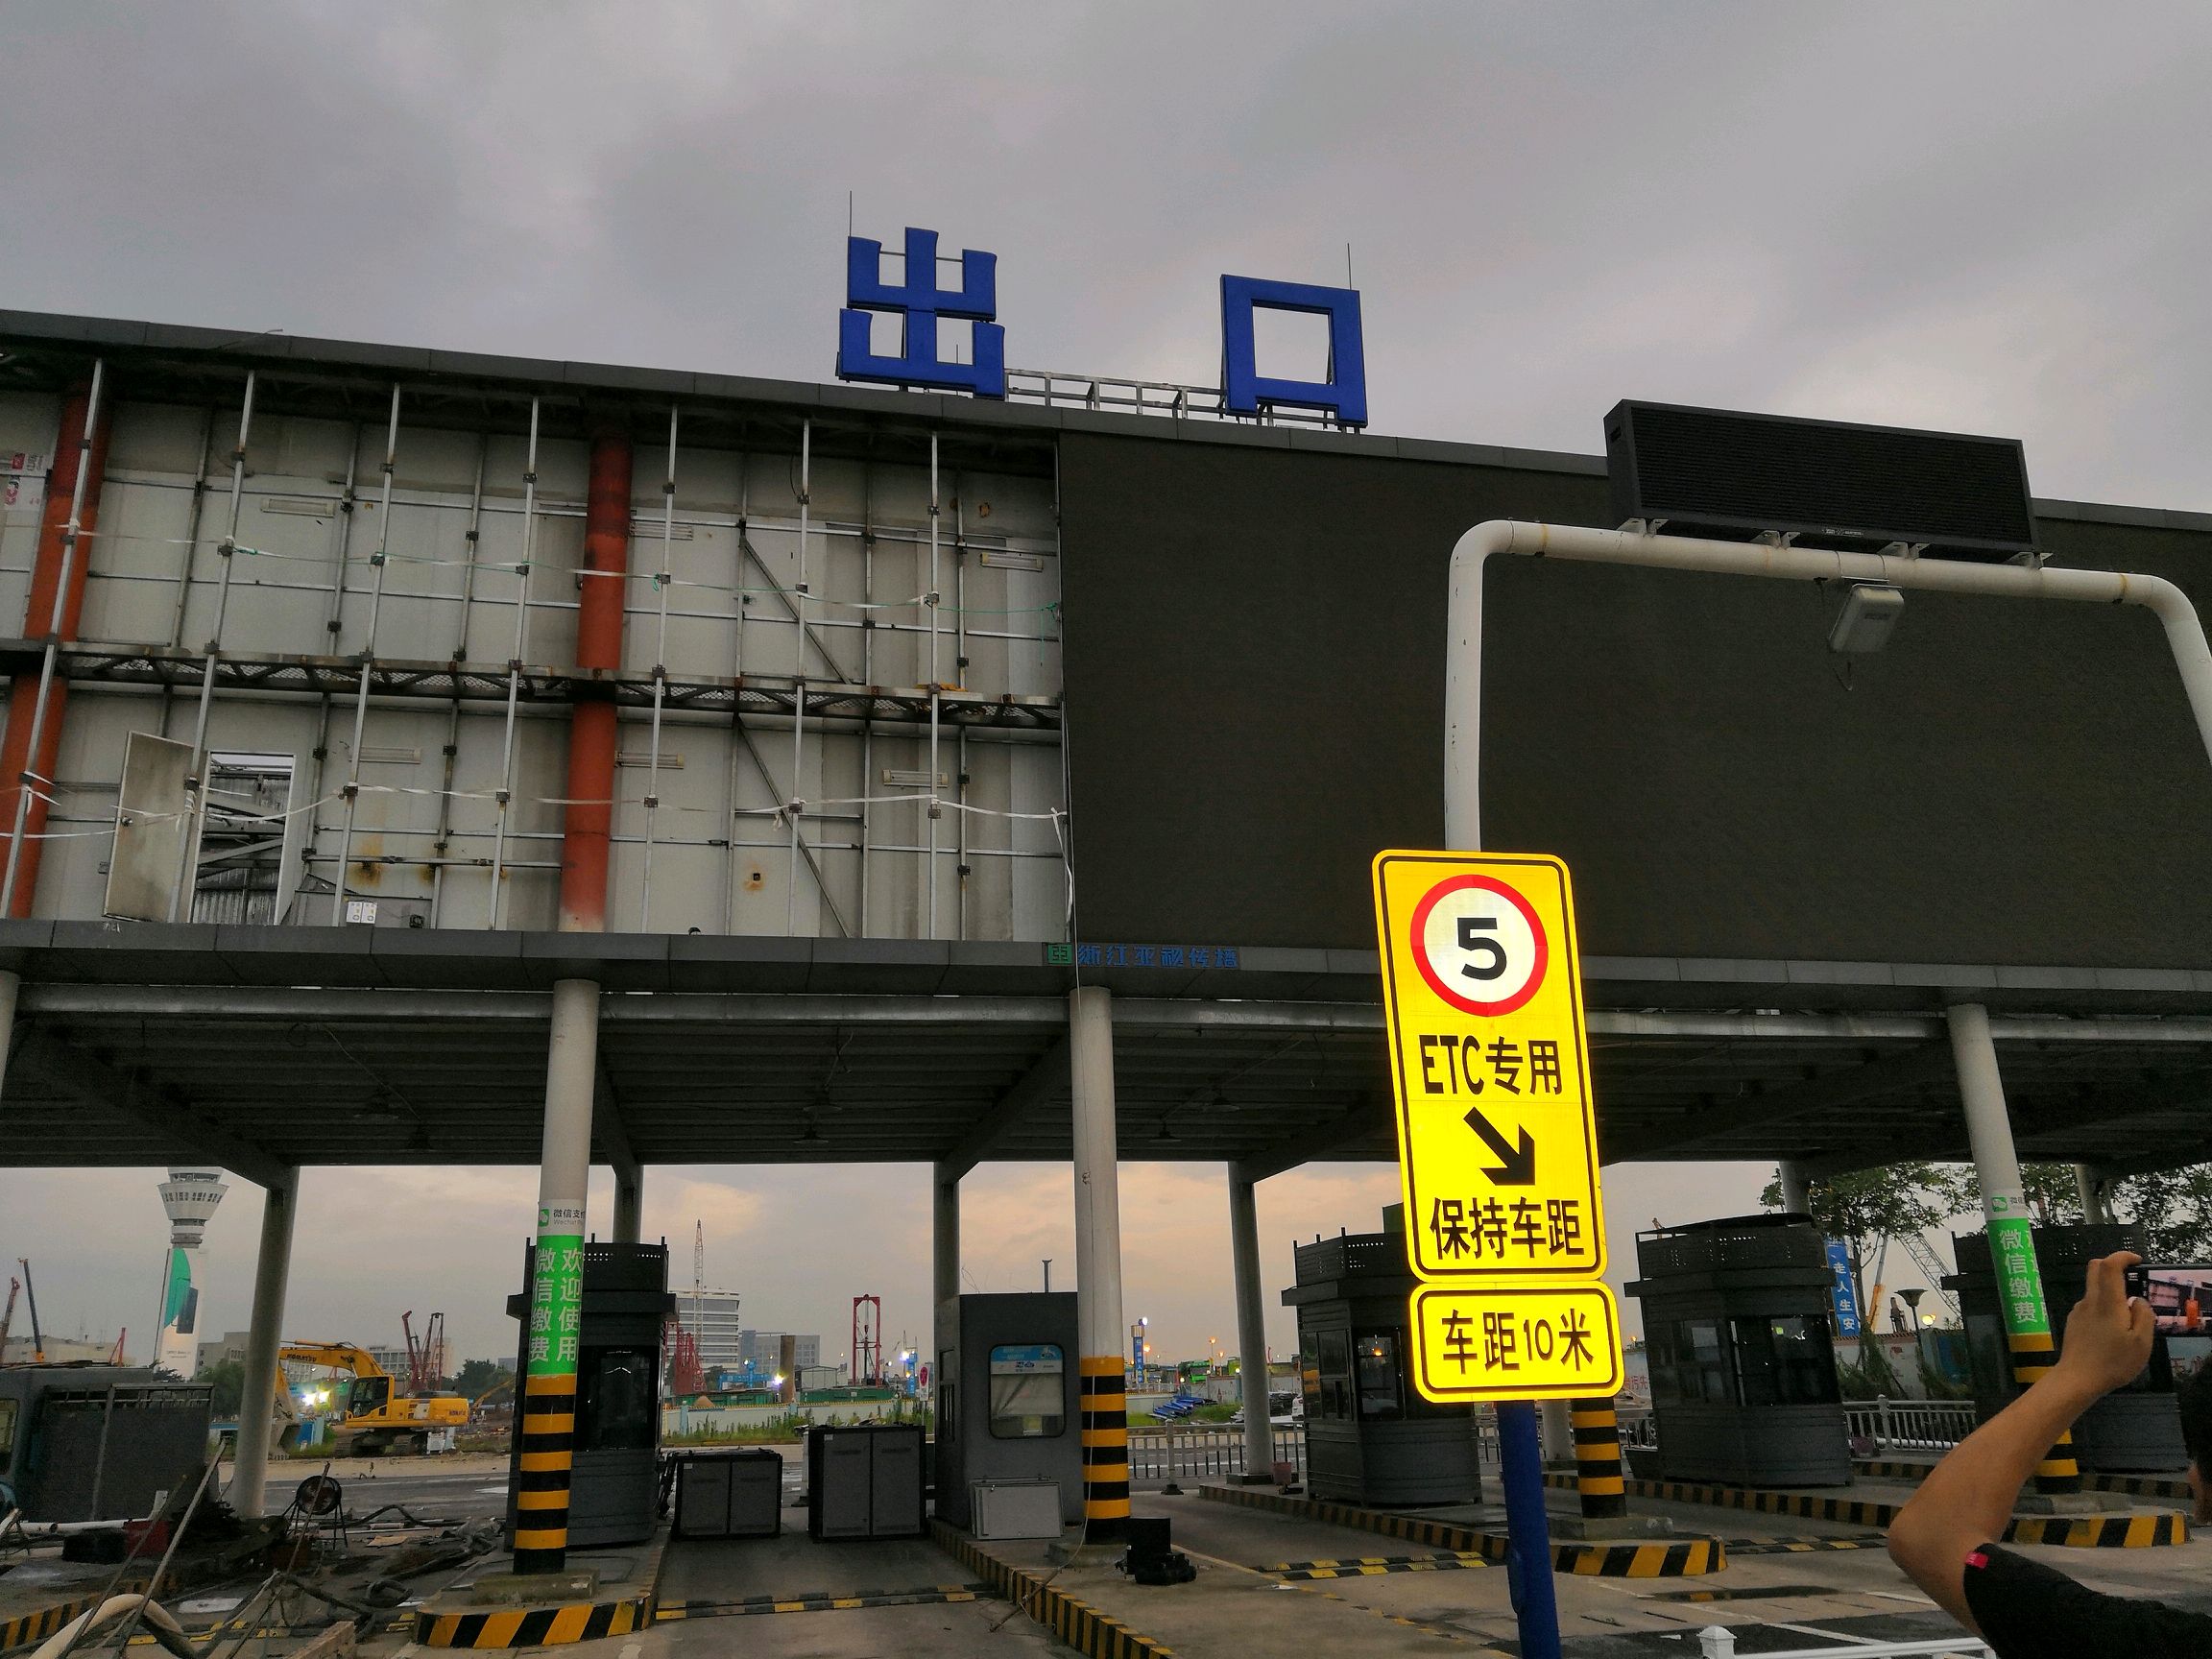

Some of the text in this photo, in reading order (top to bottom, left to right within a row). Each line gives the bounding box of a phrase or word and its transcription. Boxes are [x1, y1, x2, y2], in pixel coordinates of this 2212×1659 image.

[838, 227, 1368, 428] 出口
[1456, 917, 1507, 981] 5
[1419, 1034, 1563, 1095] ETC专用
[1430, 1196, 1585, 1260] 保持车距
[530, 1247, 555, 1363] 微信缴费
[556, 1247, 583, 1361] 欢迎使用
[1999, 1229, 2037, 1323] 微信缴费
[1442, 1308, 1594, 1374] 车距10米
